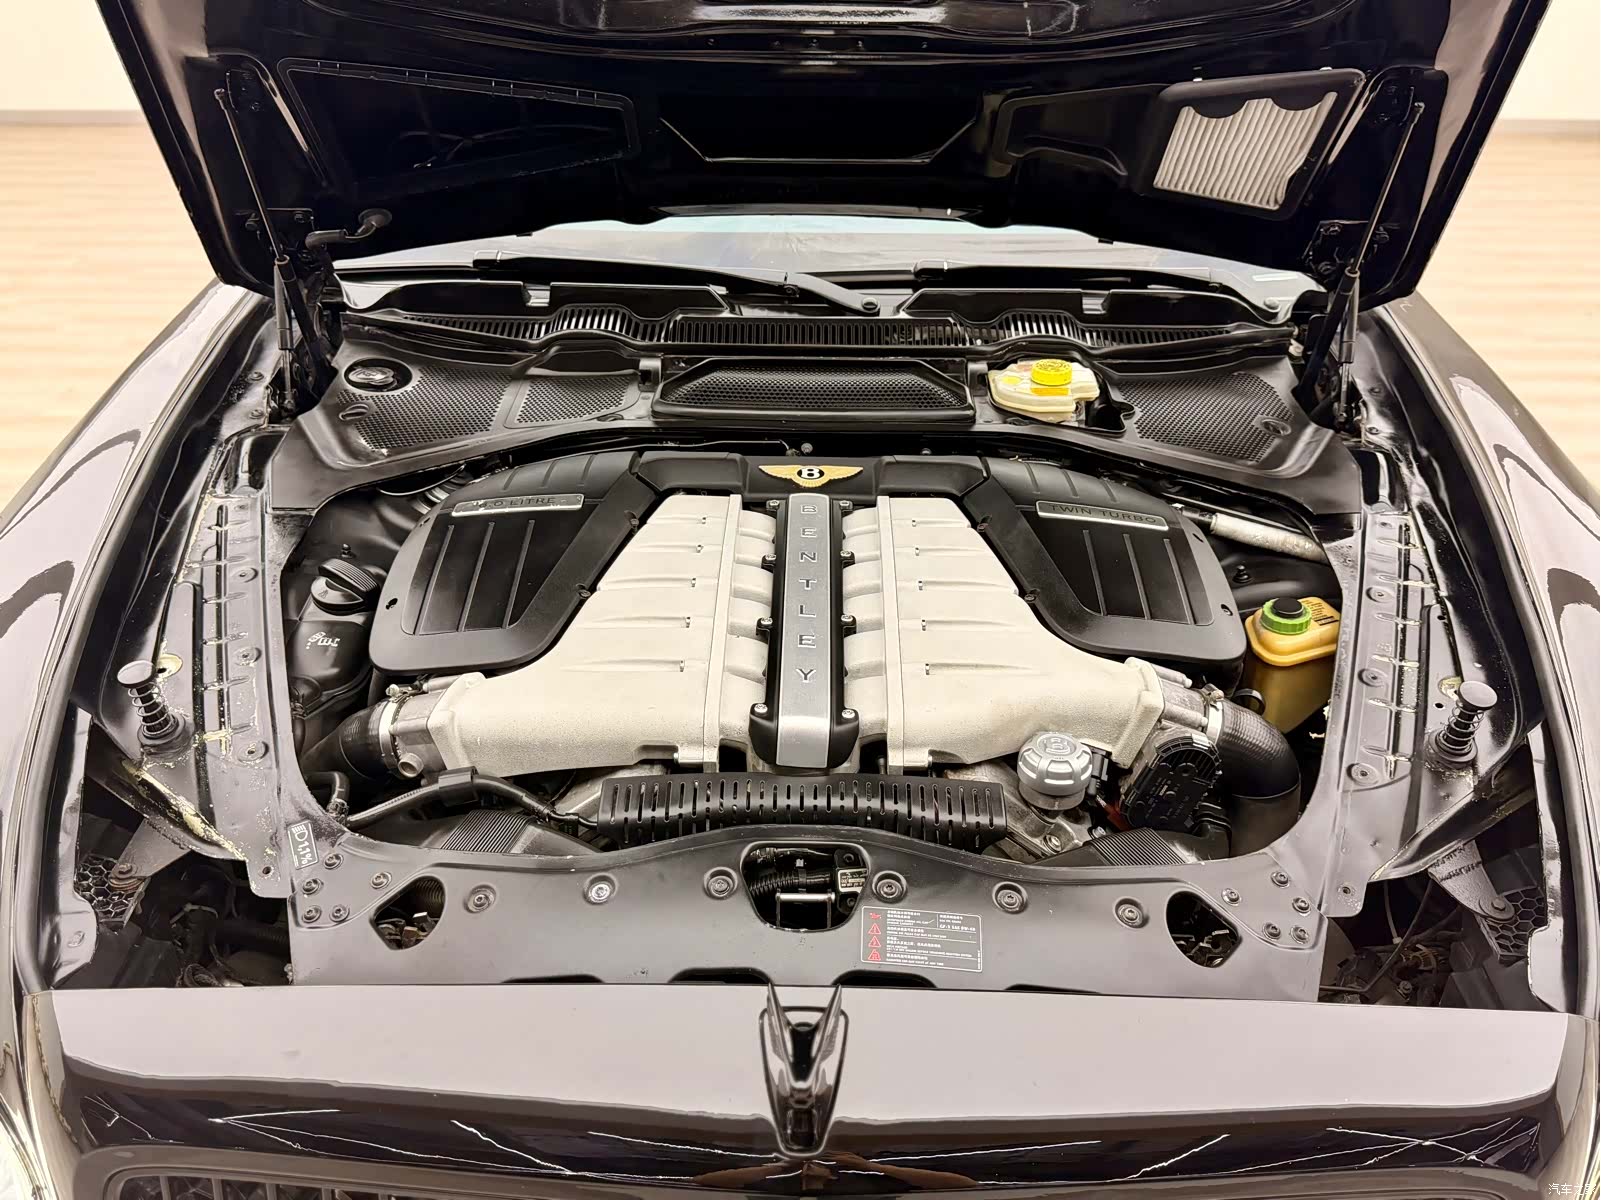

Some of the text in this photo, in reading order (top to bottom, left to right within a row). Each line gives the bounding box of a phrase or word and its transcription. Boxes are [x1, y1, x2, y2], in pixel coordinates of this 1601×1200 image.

[800, 467, 821, 478] B
[509, 497, 556, 506] LITRE
[1049, 504, 1157, 523] TWIN TURBO
[796, 504, 818, 684] BENTLEY
